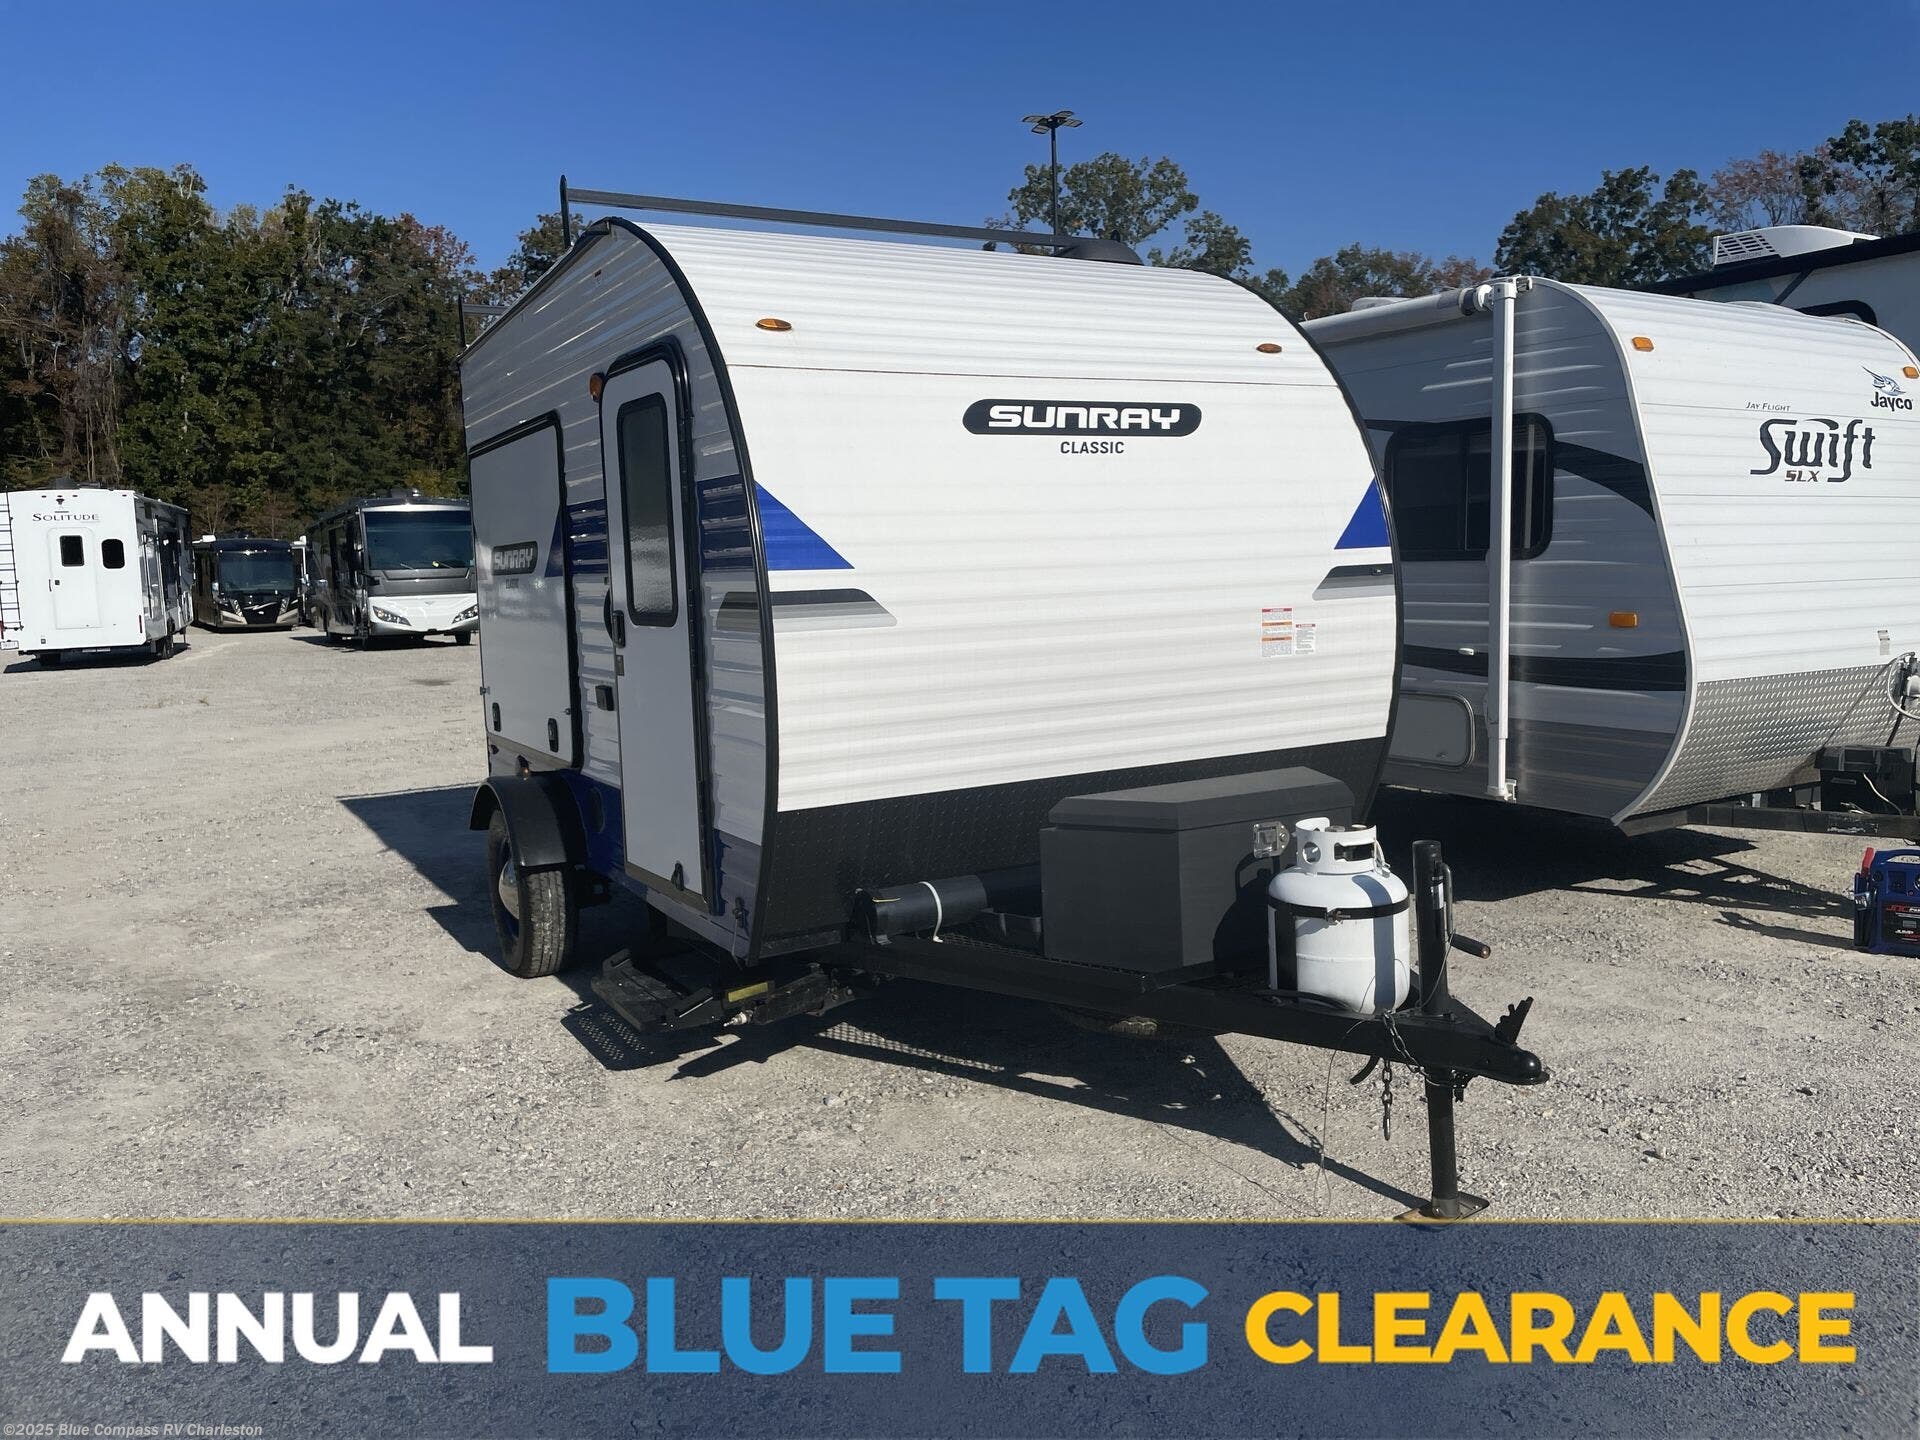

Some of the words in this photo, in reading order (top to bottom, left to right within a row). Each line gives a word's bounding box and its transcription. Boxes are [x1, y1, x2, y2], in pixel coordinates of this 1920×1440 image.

[1870, 392, 1913, 411] Jayco
[988, 405, 1181, 430] SUNRAY
[1060, 441, 1125, 454] CLASSIC
[1750, 418, 1876, 483] Swift
[1784, 469, 1820, 483] SLX
[494, 547, 534, 570] SUNRAY
